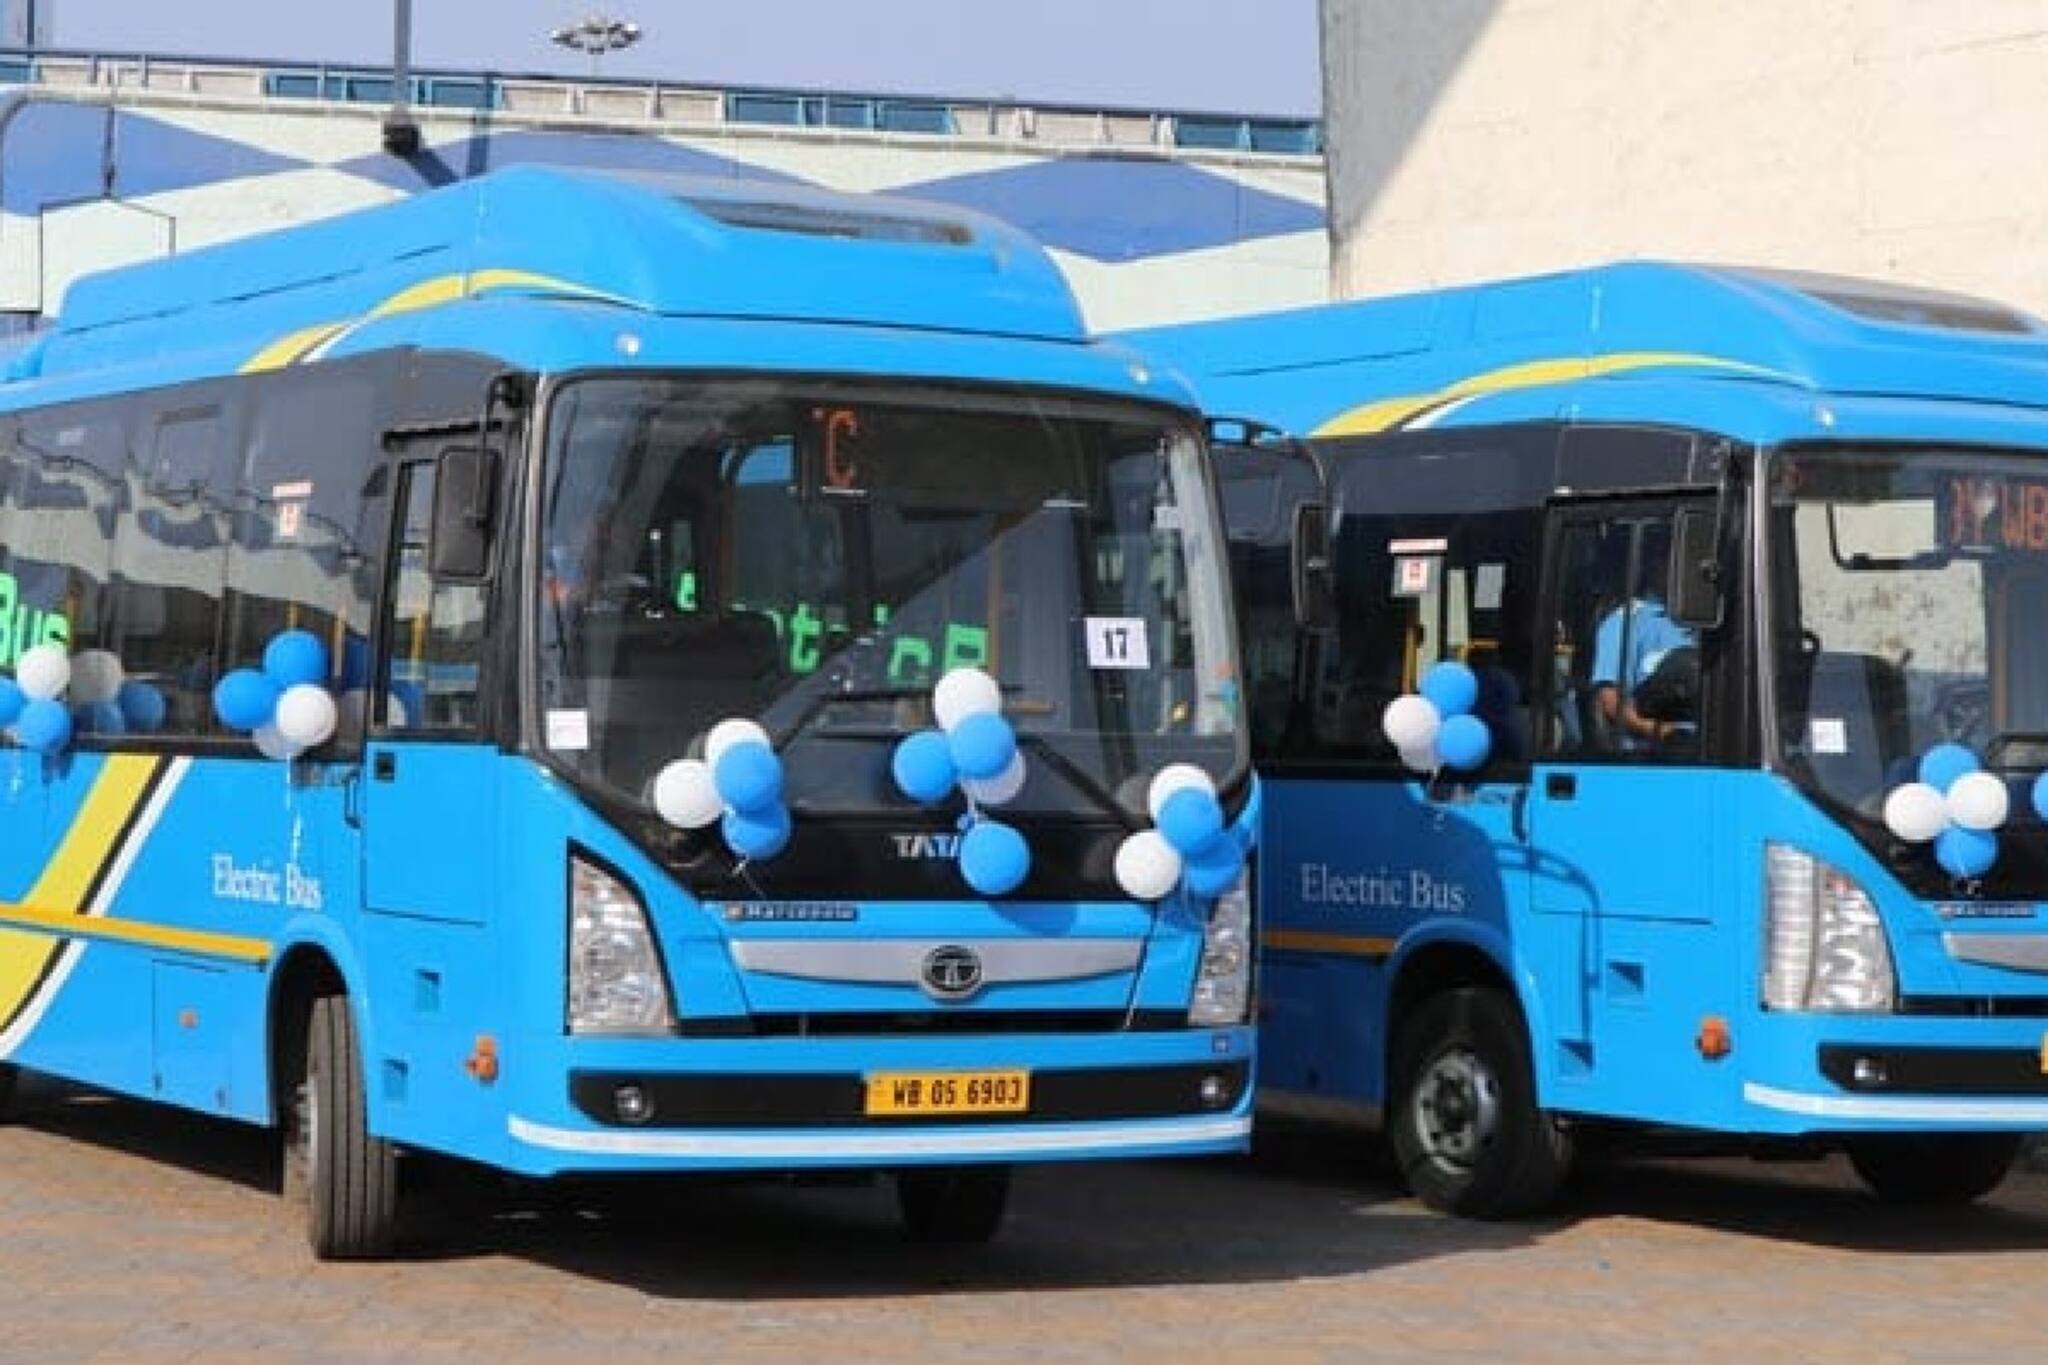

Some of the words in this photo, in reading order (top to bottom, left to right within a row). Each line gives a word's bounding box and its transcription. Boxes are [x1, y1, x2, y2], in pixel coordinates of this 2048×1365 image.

[1102, 627, 1129, 659] 17
[1301, 862, 1402, 905] Electric
[1409, 869, 1466, 913] Bus
[893, 1079, 922, 1106] WB
[931, 1079, 957, 1105] 05
